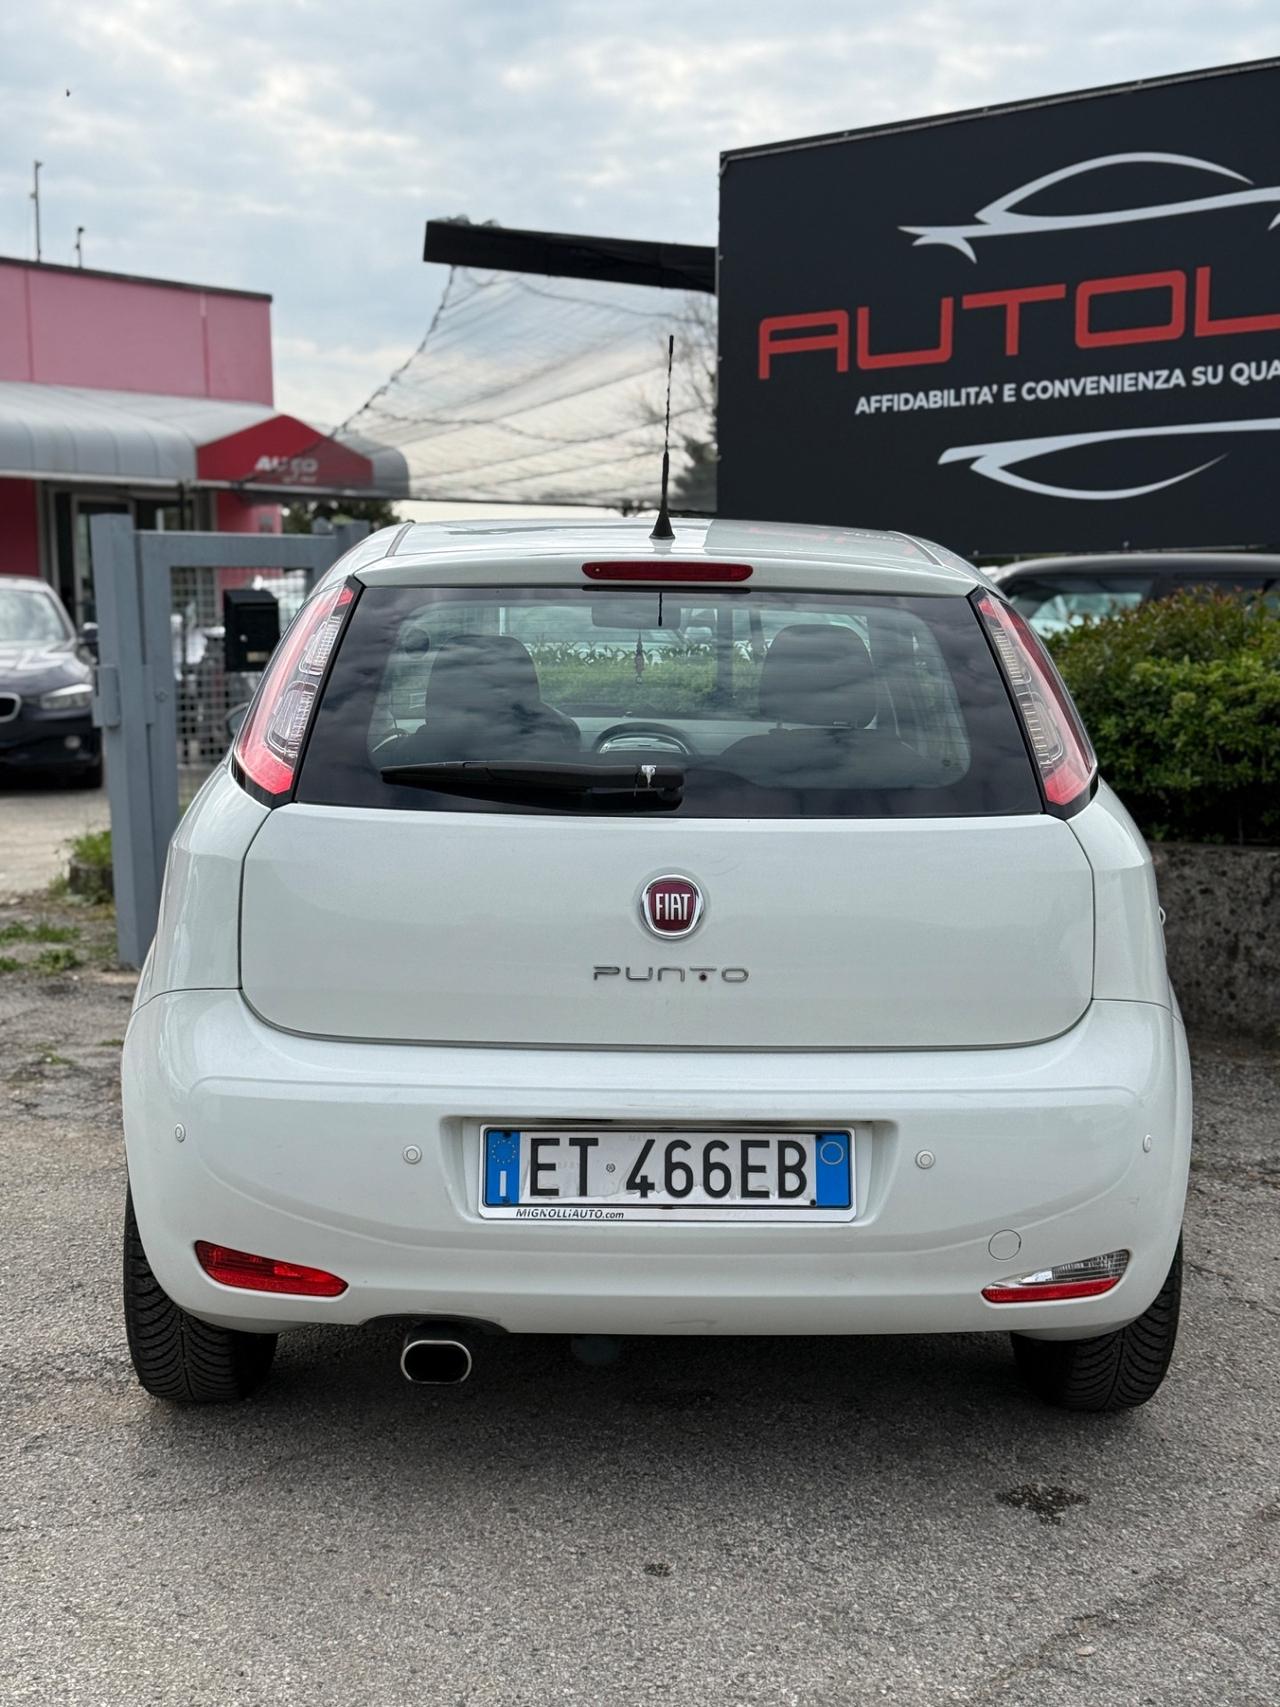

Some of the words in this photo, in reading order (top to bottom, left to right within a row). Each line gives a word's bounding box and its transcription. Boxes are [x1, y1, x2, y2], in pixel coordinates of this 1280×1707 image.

[758, 267, 1280, 379] AUTOL
[1003, 384, 1016, 402] E
[1022, 368, 1186, 401] CONVENIENZA
[1192, 364, 1223, 386] SU
[1230, 359, 1280, 386] QUA
[655, 893, 691, 920] FIAT
[593, 966, 749, 982] PUNTO
[530, 1138, 599, 1197] ET
[625, 1138, 807, 1199] 466EB
